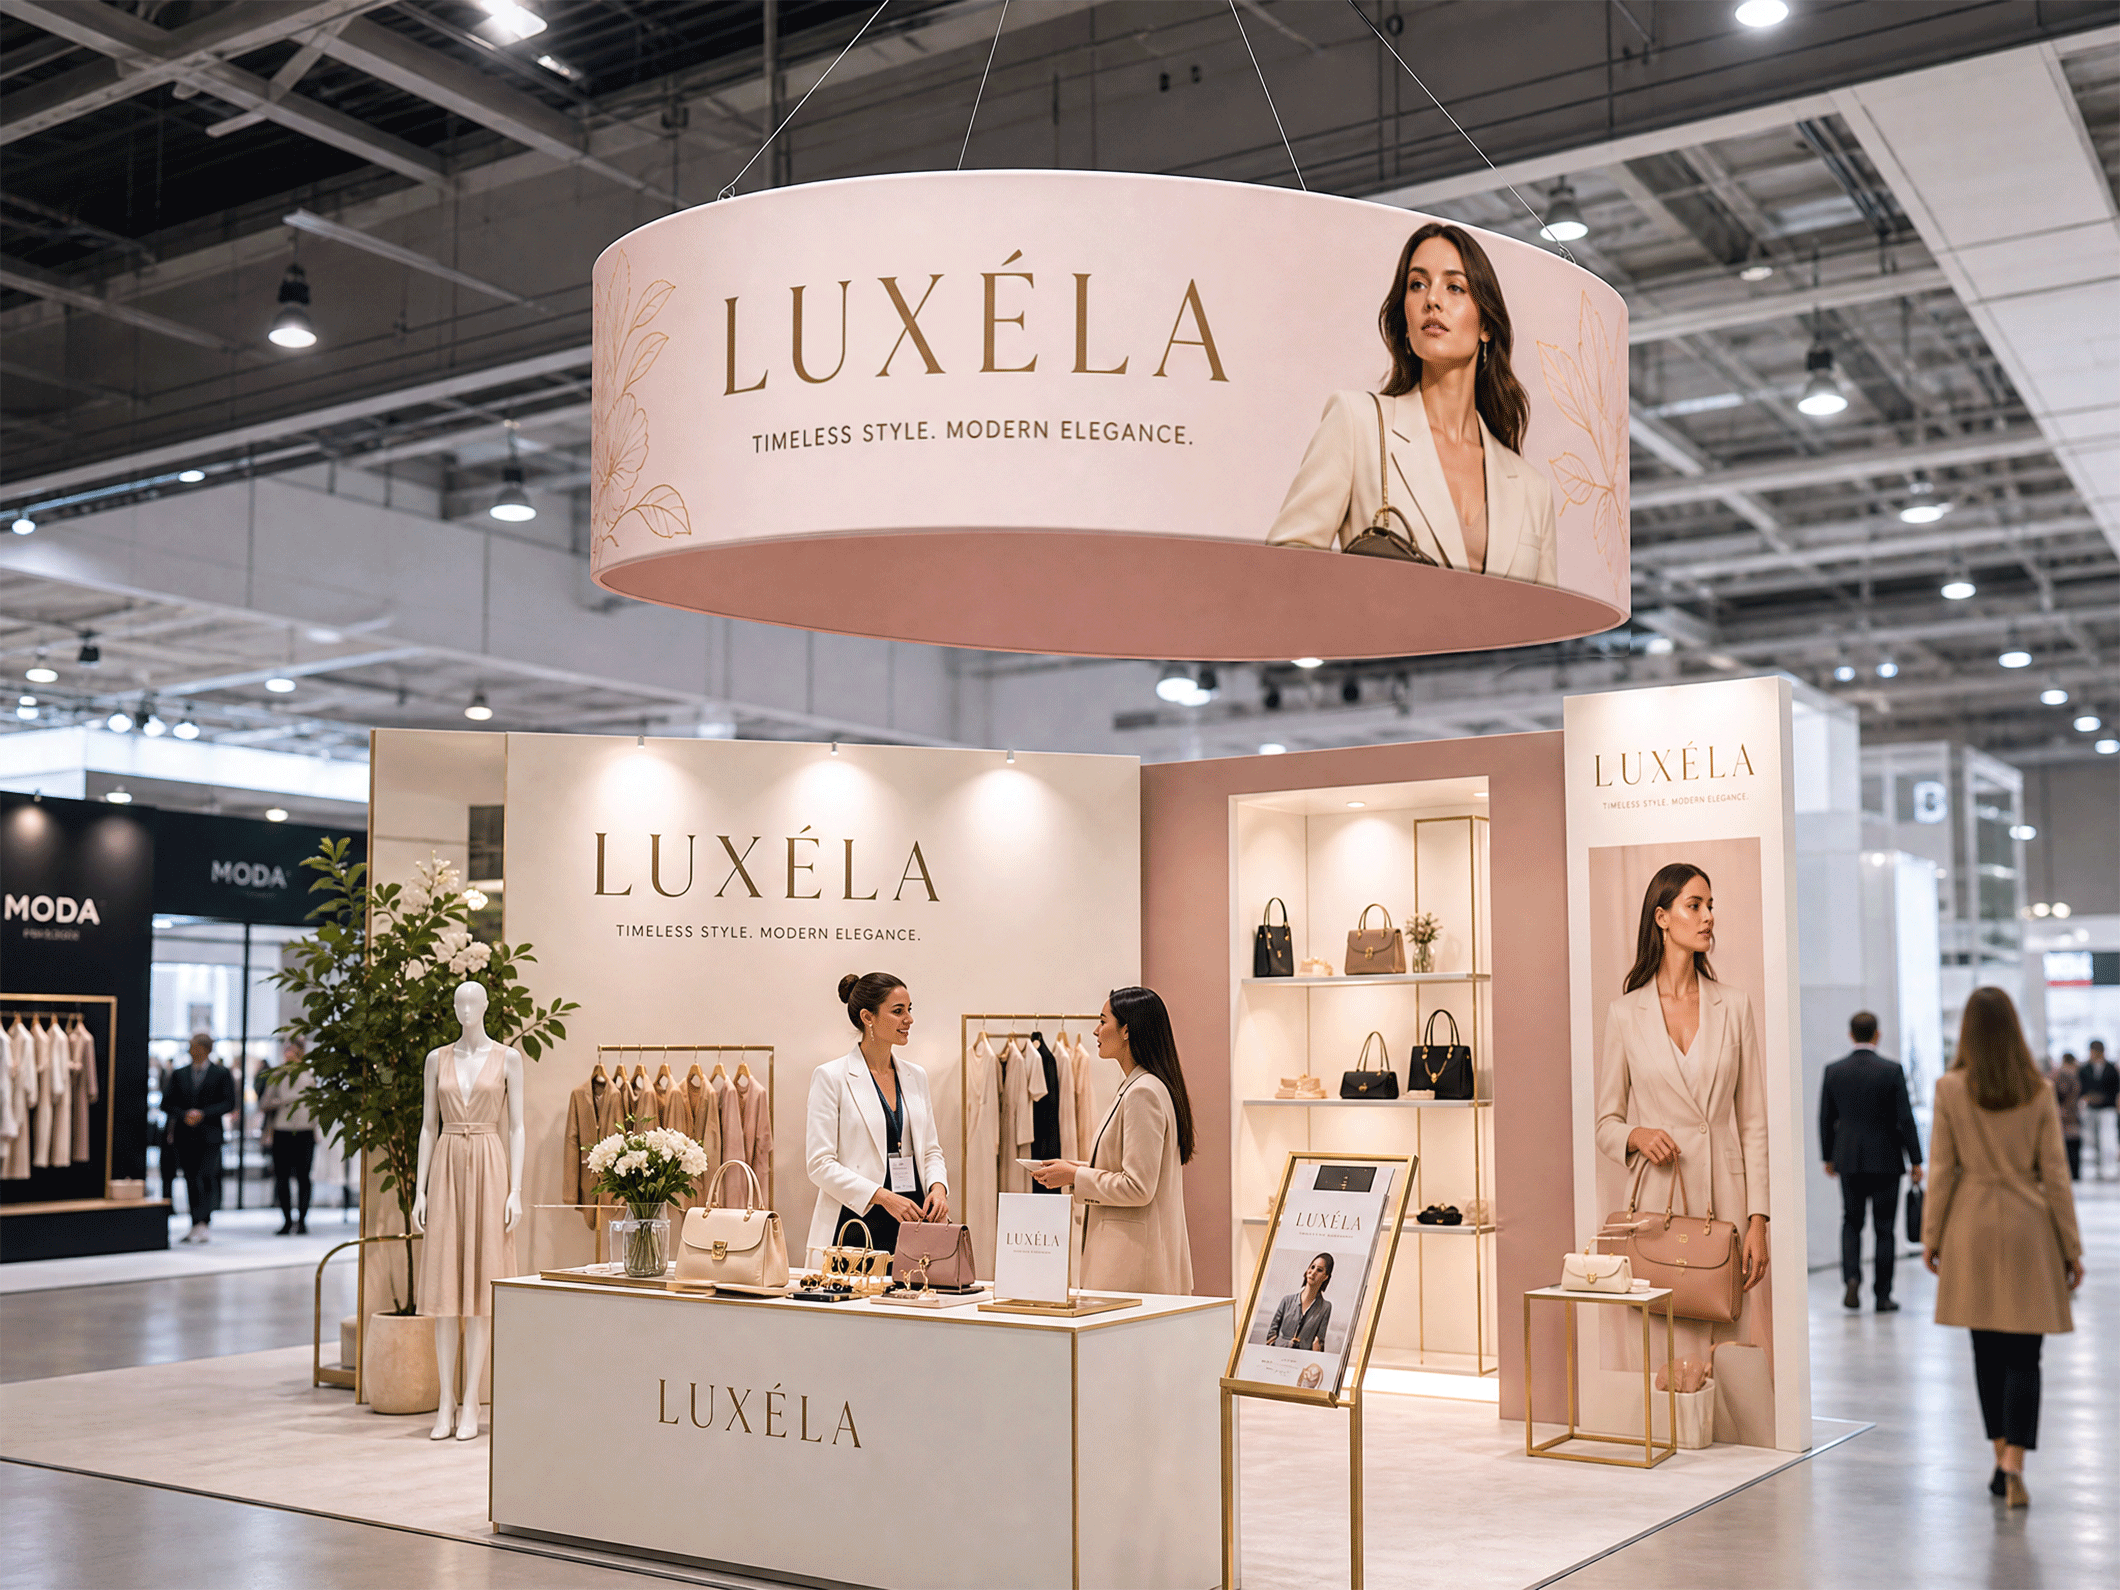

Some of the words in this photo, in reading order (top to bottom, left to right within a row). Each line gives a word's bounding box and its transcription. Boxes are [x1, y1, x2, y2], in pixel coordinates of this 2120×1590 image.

[723, 249, 1230, 396] LUXÉLA
[752, 425, 853, 454] TIMELESS
[862, 421, 937, 442] STYLE.
[945, 419, 1049, 440] MODERN
[1060, 421, 1194, 446] ELEGANCE.
[1595, 741, 1755, 787] LUXÉLA
[1603, 800, 1640, 810] TIMELESS
[1643, 798, 1669, 808] STYLE.
[1671, 796, 1705, 806] MODERN
[1707, 792, 1750, 804] ELEGANCE.
[211, 860, 288, 889] MODA
[594, 824, 941, 902] LUXÉLA
[4, 893, 101, 926] MODA
[616, 924, 694, 938] TIMELESS
[700, 925, 753, 939] STYLE.
[760, 926, 829, 940] MODERN
[835, 927, 922, 942] ELEGANCE.
[1295, 1210, 1361, 1231] LUXÉLA
[1006, 1230, 1059, 1247] LUXÉLA
[658, 1378, 862, 1449] LUXÉLA
